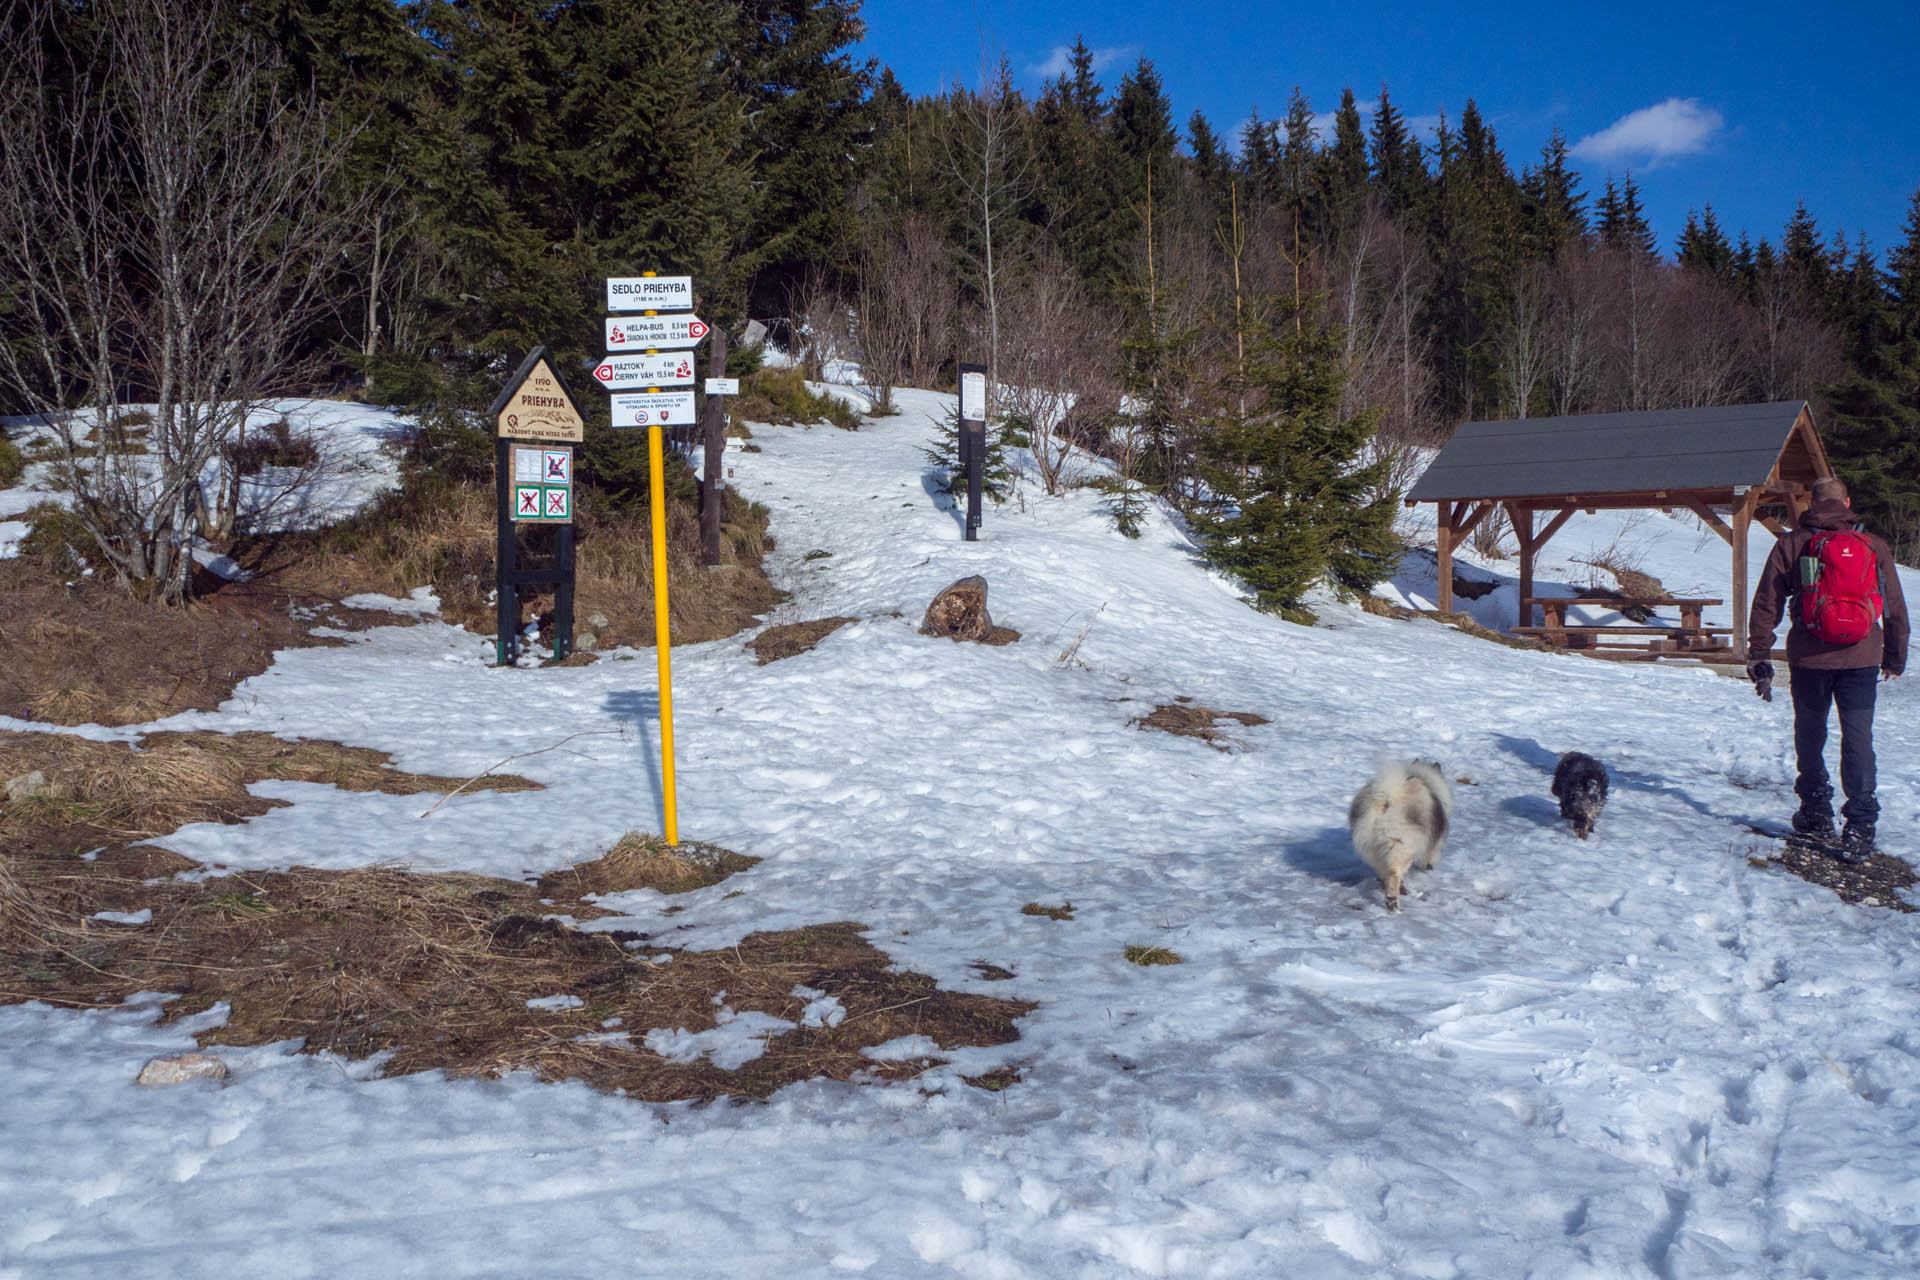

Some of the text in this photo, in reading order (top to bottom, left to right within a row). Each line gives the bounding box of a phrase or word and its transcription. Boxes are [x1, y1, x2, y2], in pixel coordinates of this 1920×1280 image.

[612, 283, 686, 294] SEDLO PRIEHYBA
[681, 331, 688, 339] km
[614, 361, 645, 370] RÁZTOKY
[667, 360, 675, 368] km
[615, 372, 638, 381] ČIERNY
[640, 370, 654, 379] VÁH
[668, 369, 675, 377] km
[535, 378, 551, 386] 1190
[522, 395, 564, 408] PRIEHYBA
